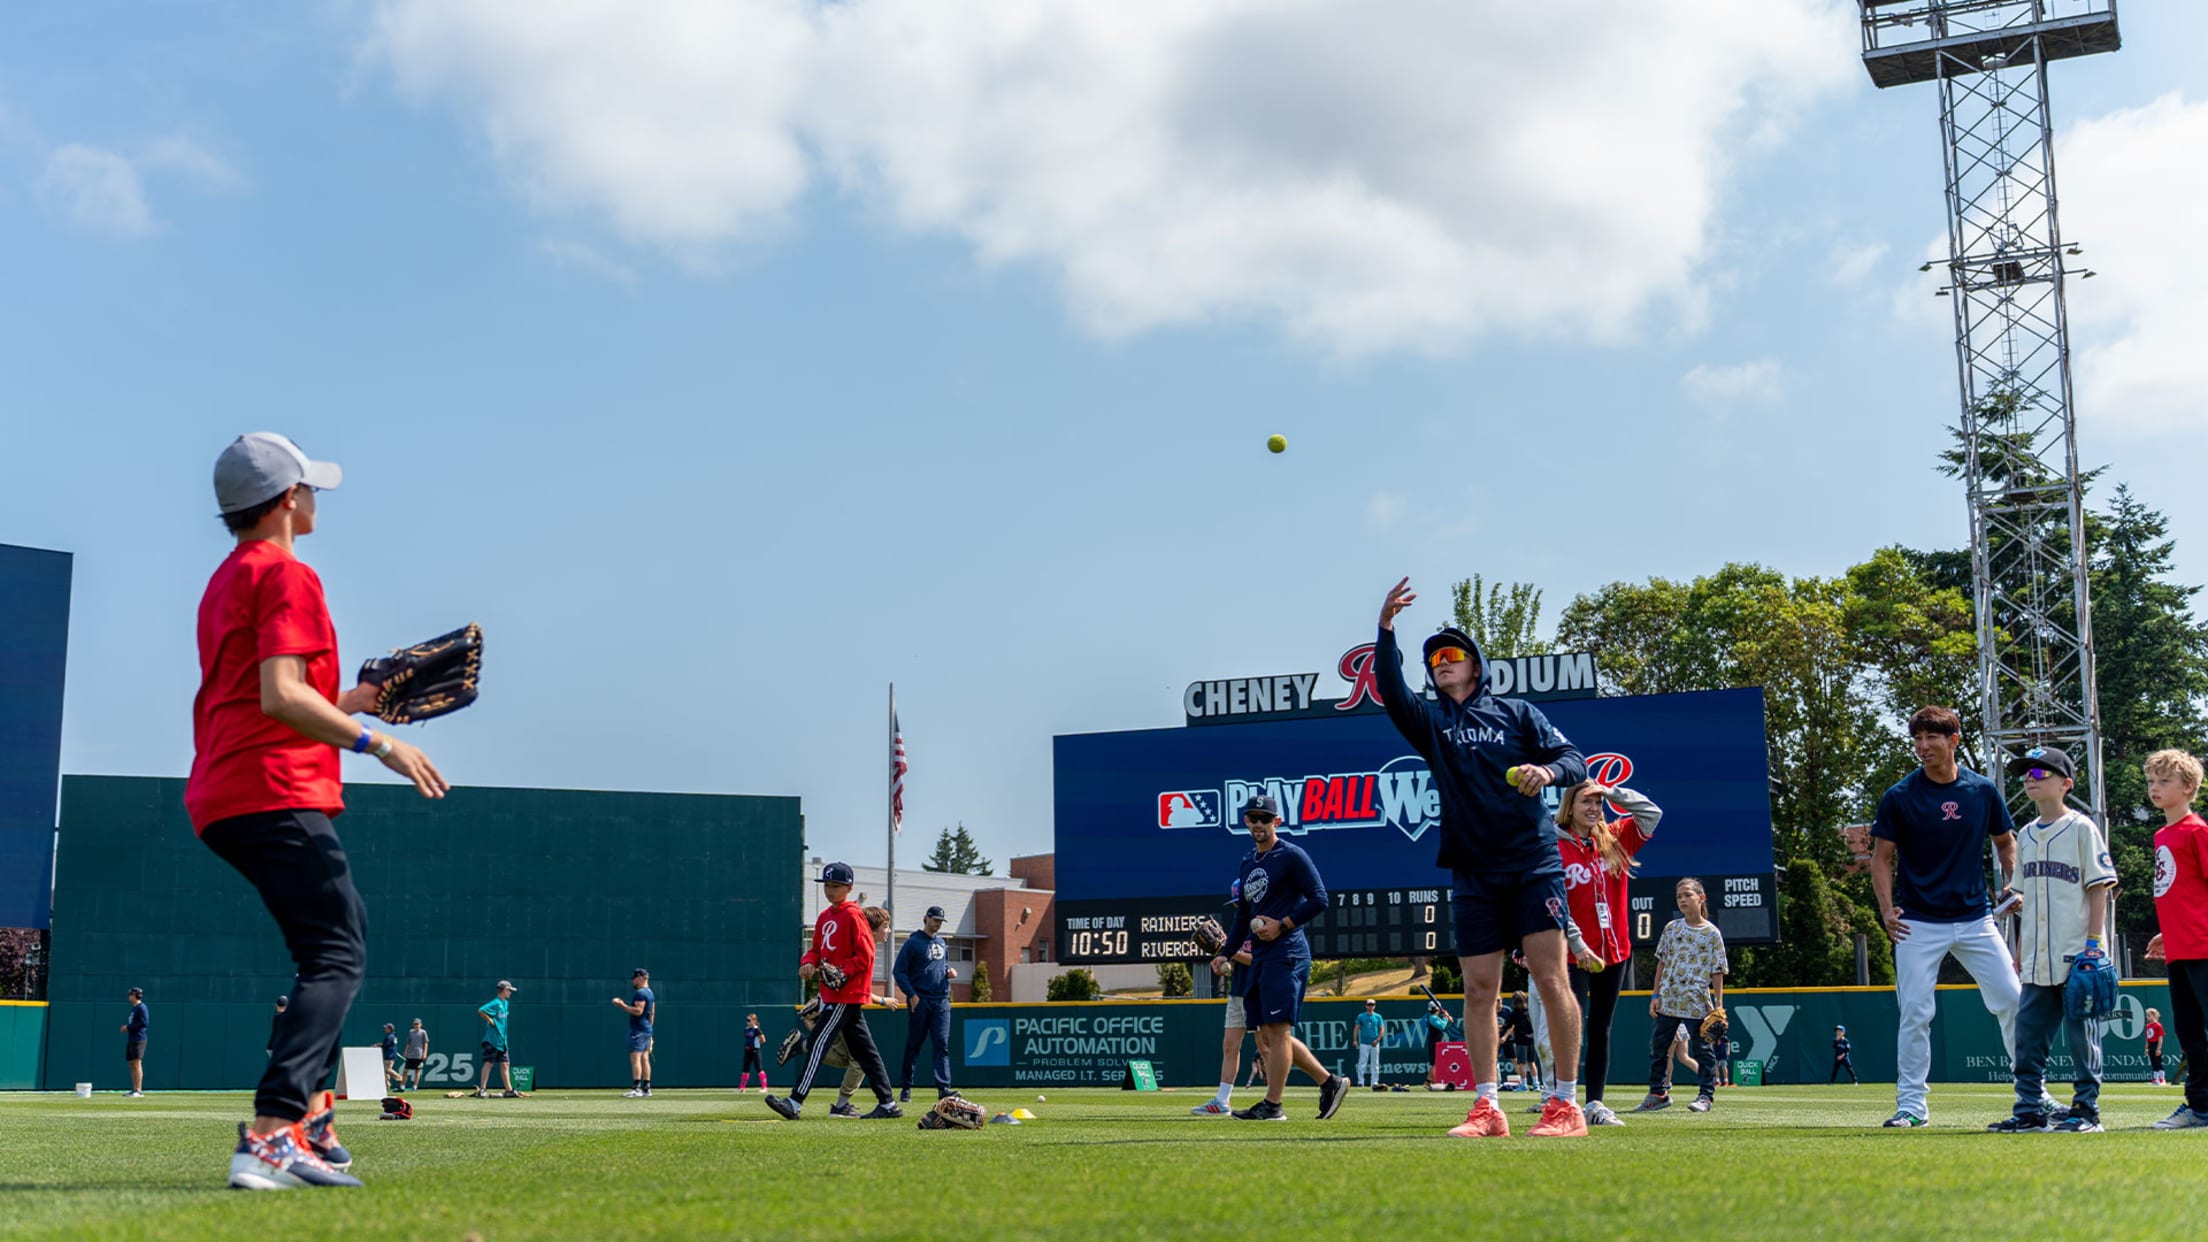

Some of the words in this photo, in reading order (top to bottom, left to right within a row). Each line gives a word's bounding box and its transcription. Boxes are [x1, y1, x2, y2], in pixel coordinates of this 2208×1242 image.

[1184, 674, 1316, 718] CHENEY
[1442, 727, 1504, 745] TCOMA
[2023, 861, 2080, 884] RINERS
[1724, 878, 1759, 892] PITCH
[1337, 894, 1345, 906] 7
[1352, 893, 1359, 906] 8
[1366, 892, 1374, 905] 9
[1388, 891, 1401, 904] 10
[1409, 890, 1439, 903] RUNS
[1632, 897, 1653, 910] OUT
[1724, 893, 1762, 907] SPEED
[1424, 905, 1435, 923] 0
[1067, 917, 1090, 930] TIME
[1092, 917, 1106, 929] OF
[1106, 916, 1125, 929] DAY
[1637, 912, 1650, 939] 0
[821, 919, 838, 951] R
[1071, 931, 1129, 956] 10:50
[1425, 931, 1436, 950] 0
[1141, 941, 1212, 958] RIVERCA
[1016, 1017, 1087, 1036] PACIFIC
[1093, 1016, 1164, 1034] OFFICE
[1024, 1036, 1156, 1055] AUTOMATION
[1033, 1058, 1093, 1067] PROBLEM
[1737, 1060, 1759, 1069] QUICK
[1966, 1055, 1996, 1068] BEN
[2045, 1055, 2075, 1068] NEY
[2102, 1054, 2183, 1067] UNDATON
[1015, 1070, 1076, 1081] MANAGED
[1102, 1070, 1164, 1081] SERS
[2103, 1070, 2152, 1081] communiti
